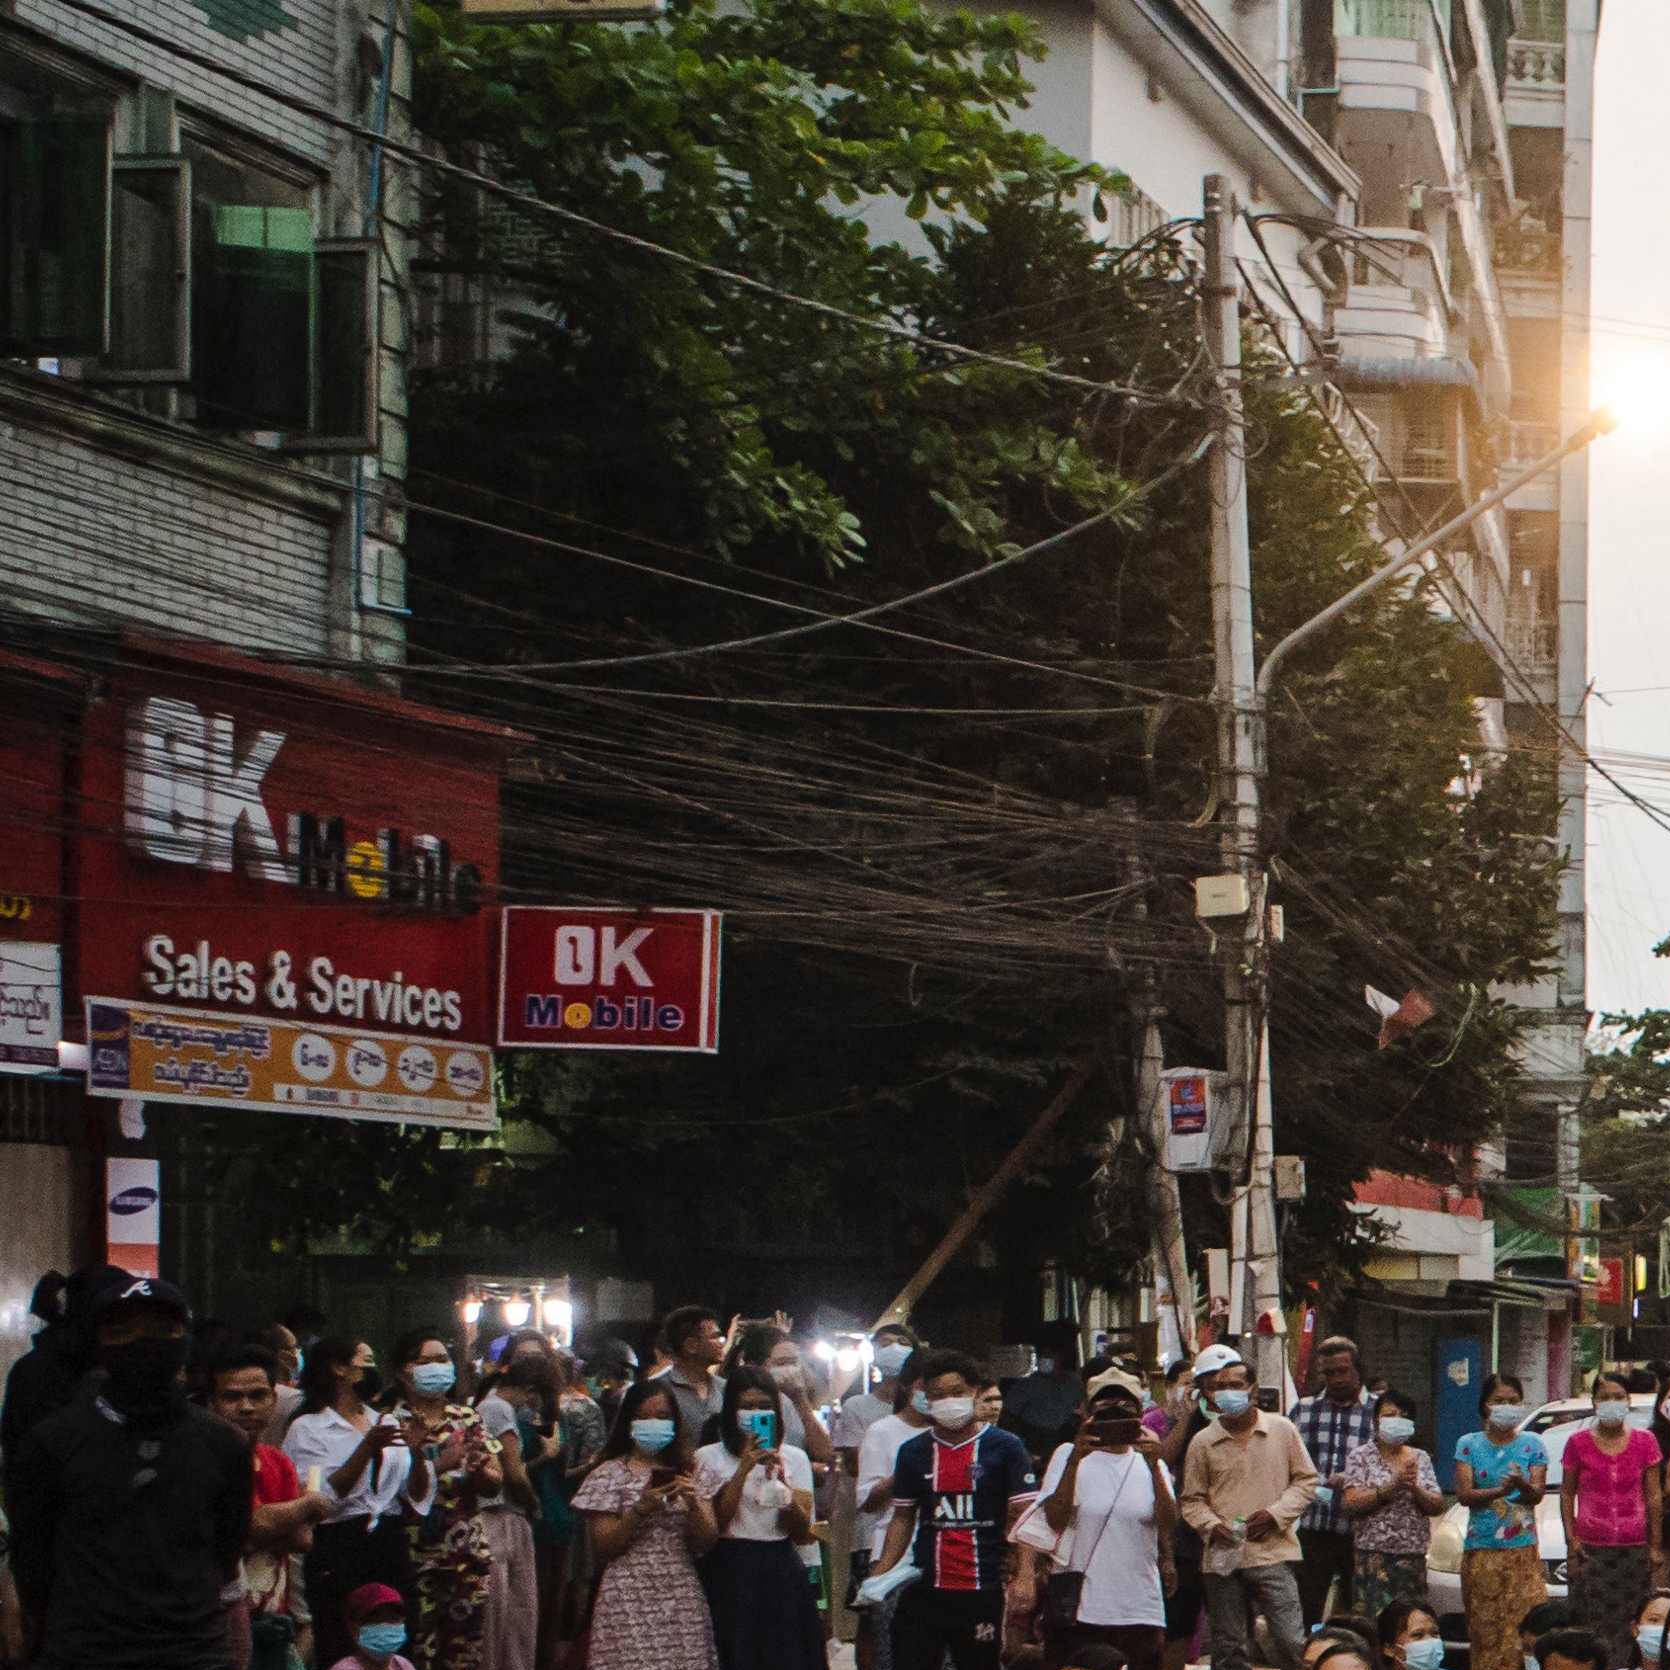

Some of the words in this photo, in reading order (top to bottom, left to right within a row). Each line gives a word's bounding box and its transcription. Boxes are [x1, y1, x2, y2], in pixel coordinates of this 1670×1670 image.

[126, 697, 300, 885] OK
[144, 934, 256, 1005] Sales
[266, 949, 298, 1011] &
[308, 956, 463, 1031] Services
[555, 925, 655, 987] OK
[524, 993, 686, 1031] Mobile
